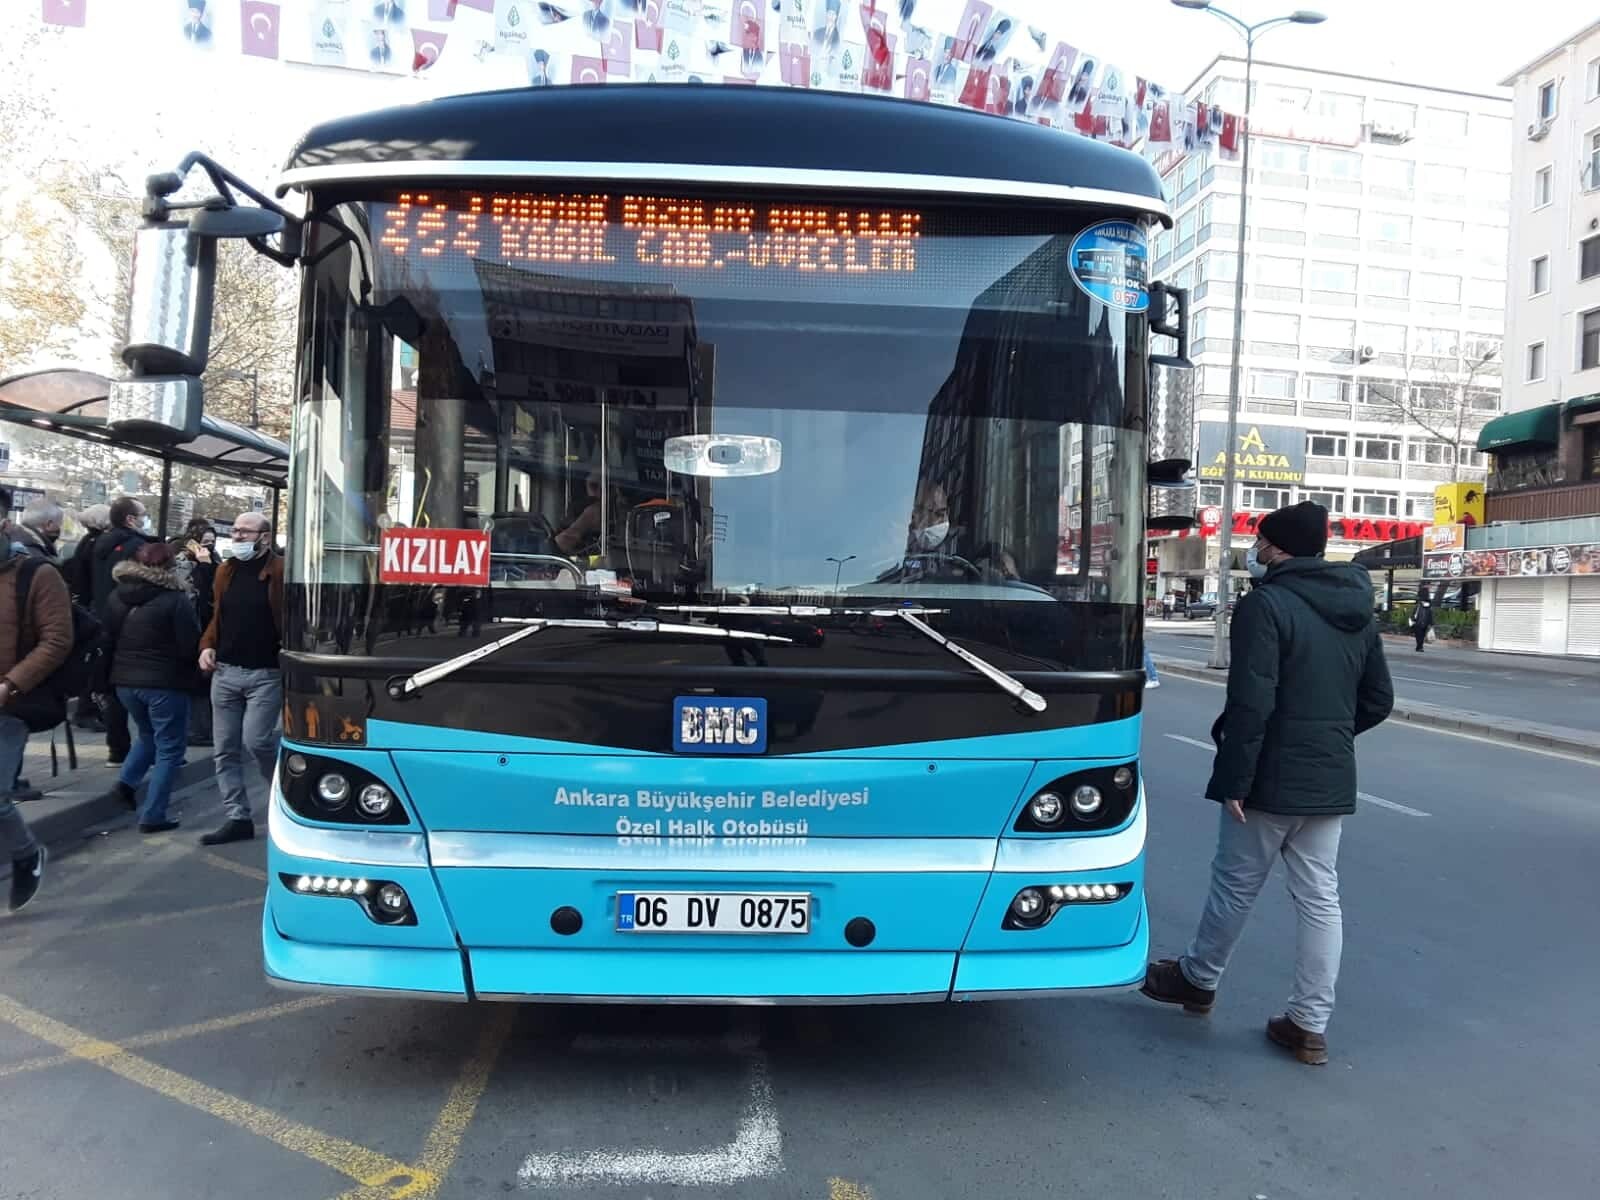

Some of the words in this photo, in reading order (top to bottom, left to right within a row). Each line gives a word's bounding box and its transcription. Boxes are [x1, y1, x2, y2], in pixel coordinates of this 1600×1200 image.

[1248, 469, 1302, 482] KURUMU
[383, 536, 487, 576] KIZILAY
[680, 705, 759, 745] BMC
[554, 786, 630, 808] Ankara
[636, 790, 755, 814] Büyükşehir
[761, 787, 869, 811] Belediyesi
[615, 817, 661, 837] Özel
[668, 819, 716, 837] Halk
[722, 818, 808, 837] Otobüsü
[620, 915, 633, 924] TR
[635, 896, 668, 928] 06
[687, 897, 721, 928] DV
[740, 898, 807, 929] 0875
